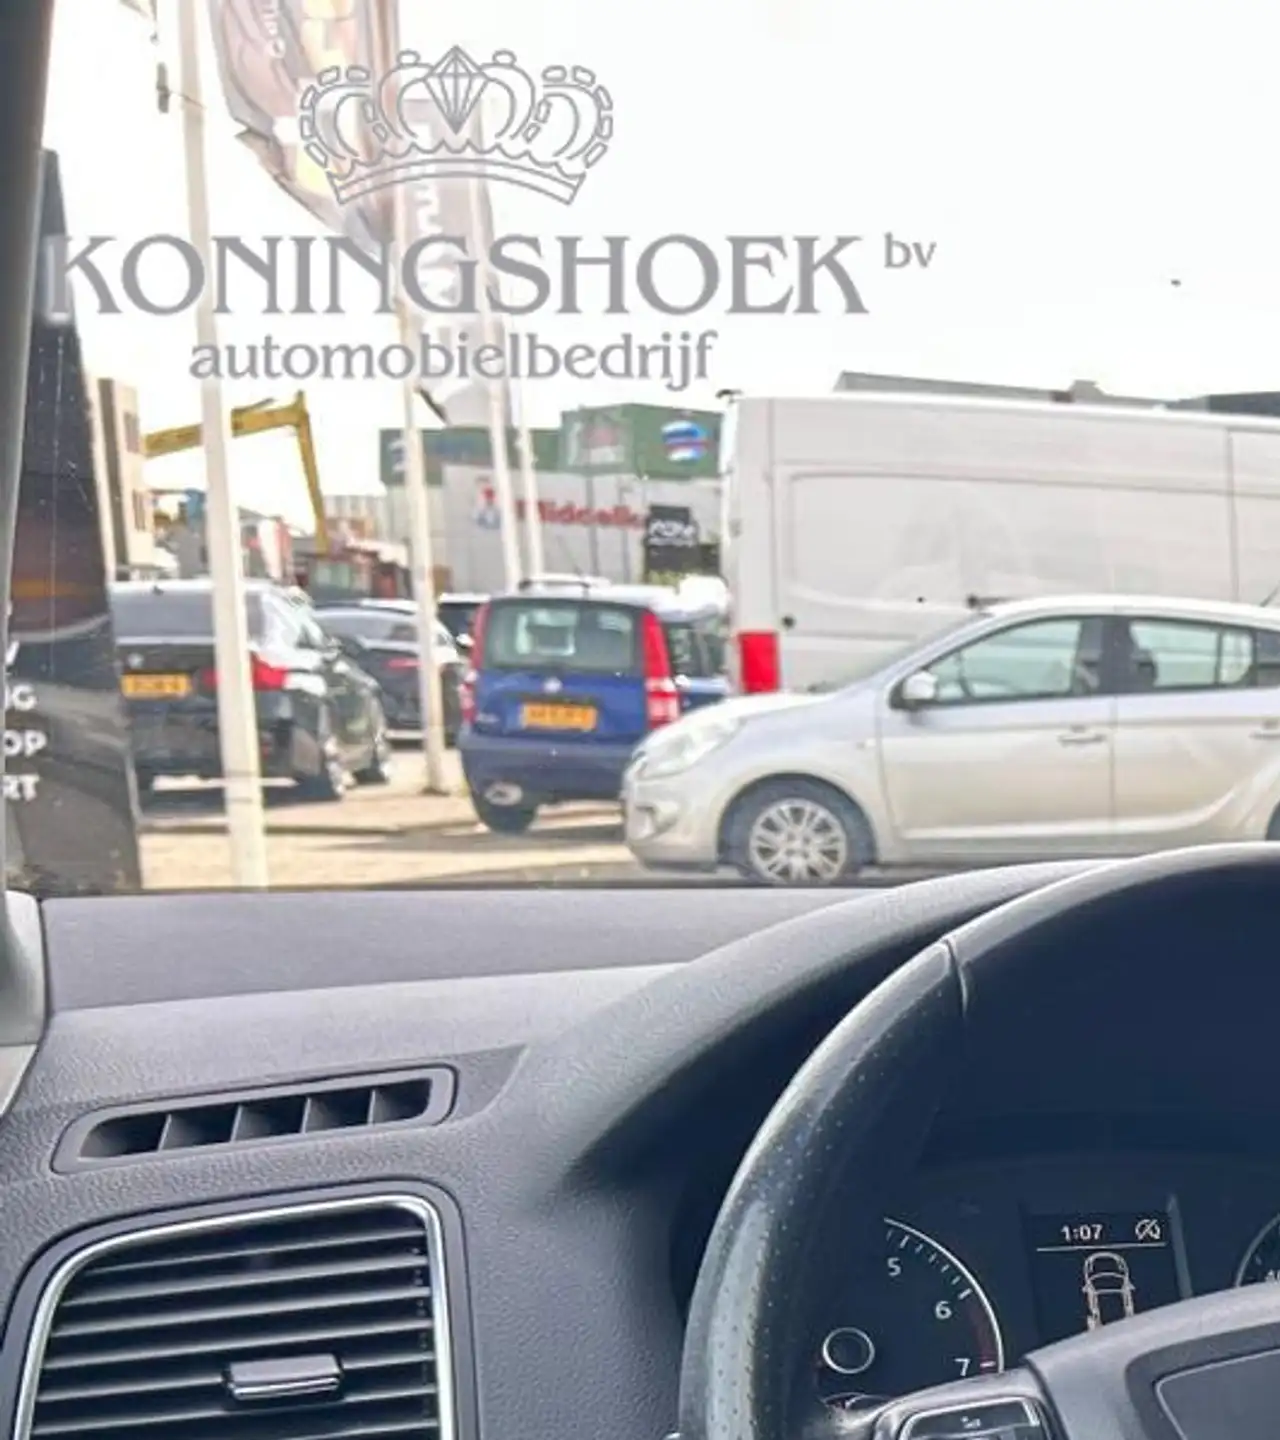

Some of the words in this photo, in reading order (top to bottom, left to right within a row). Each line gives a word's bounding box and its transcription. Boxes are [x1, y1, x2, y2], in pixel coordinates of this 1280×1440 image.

[1061, 1224, 1103, 1242] 1:07
[887, 1257, 901, 1277] 5
[935, 1301, 952, 1320] 6
[955, 1358, 971, 1377] 7
